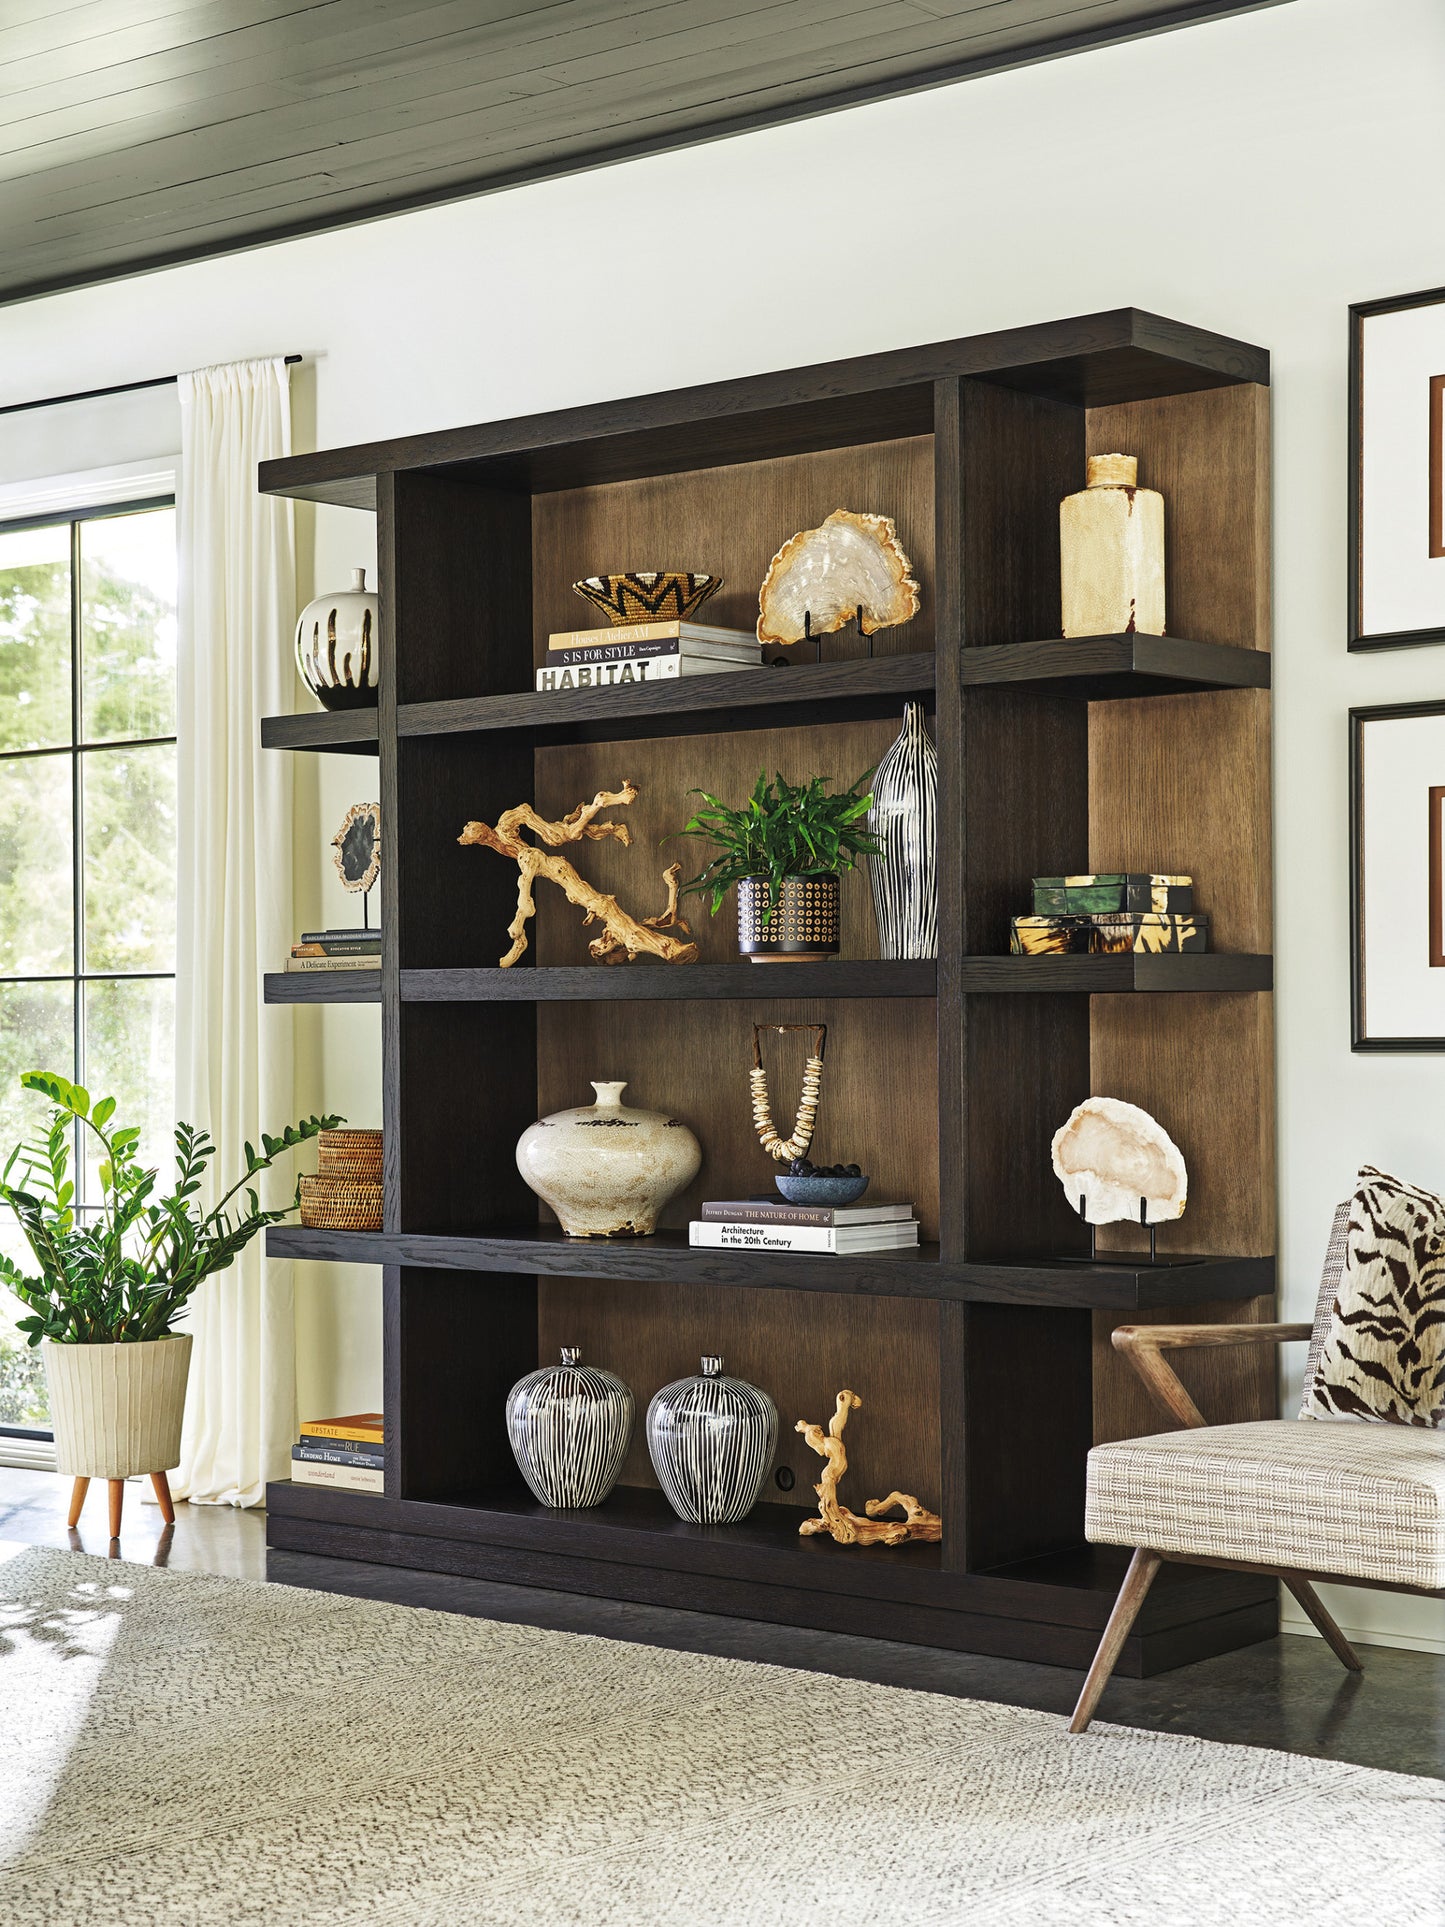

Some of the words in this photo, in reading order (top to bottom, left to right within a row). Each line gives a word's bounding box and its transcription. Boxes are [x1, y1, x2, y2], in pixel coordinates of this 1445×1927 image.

[571, 633, 599, 645] Houses
[604, 629, 632, 641] Atelier
[633, 626, 649, 638] AM
[563, 652, 570, 663] S
[572, 650, 582, 662] IS
[584, 649, 603, 660] FOR
[605, 645, 635, 659] STYLE
[542, 661, 650, 690] HABITAT
[300, 961, 305, 969] A
[306, 960, 326, 968] Delicate
[327, 960, 357, 969] Experiment
[745, 1210, 760, 1218] THE
[760, 1211, 787, 1219] NATURE
[788, 1212, 798, 1220] OF
[798, 1213, 820, 1221] HOME
[721, 1225, 764, 1236] Architecture
[721, 1235, 728, 1244] in
[730, 1235, 742, 1244] the
[744, 1236, 761, 1245] 20th
[763, 1237, 792, 1249] Century
[311, 1426, 339, 1436] UPSTATE
[345, 1441, 360, 1452] RUE
[323, 1451, 341, 1462] HOME
